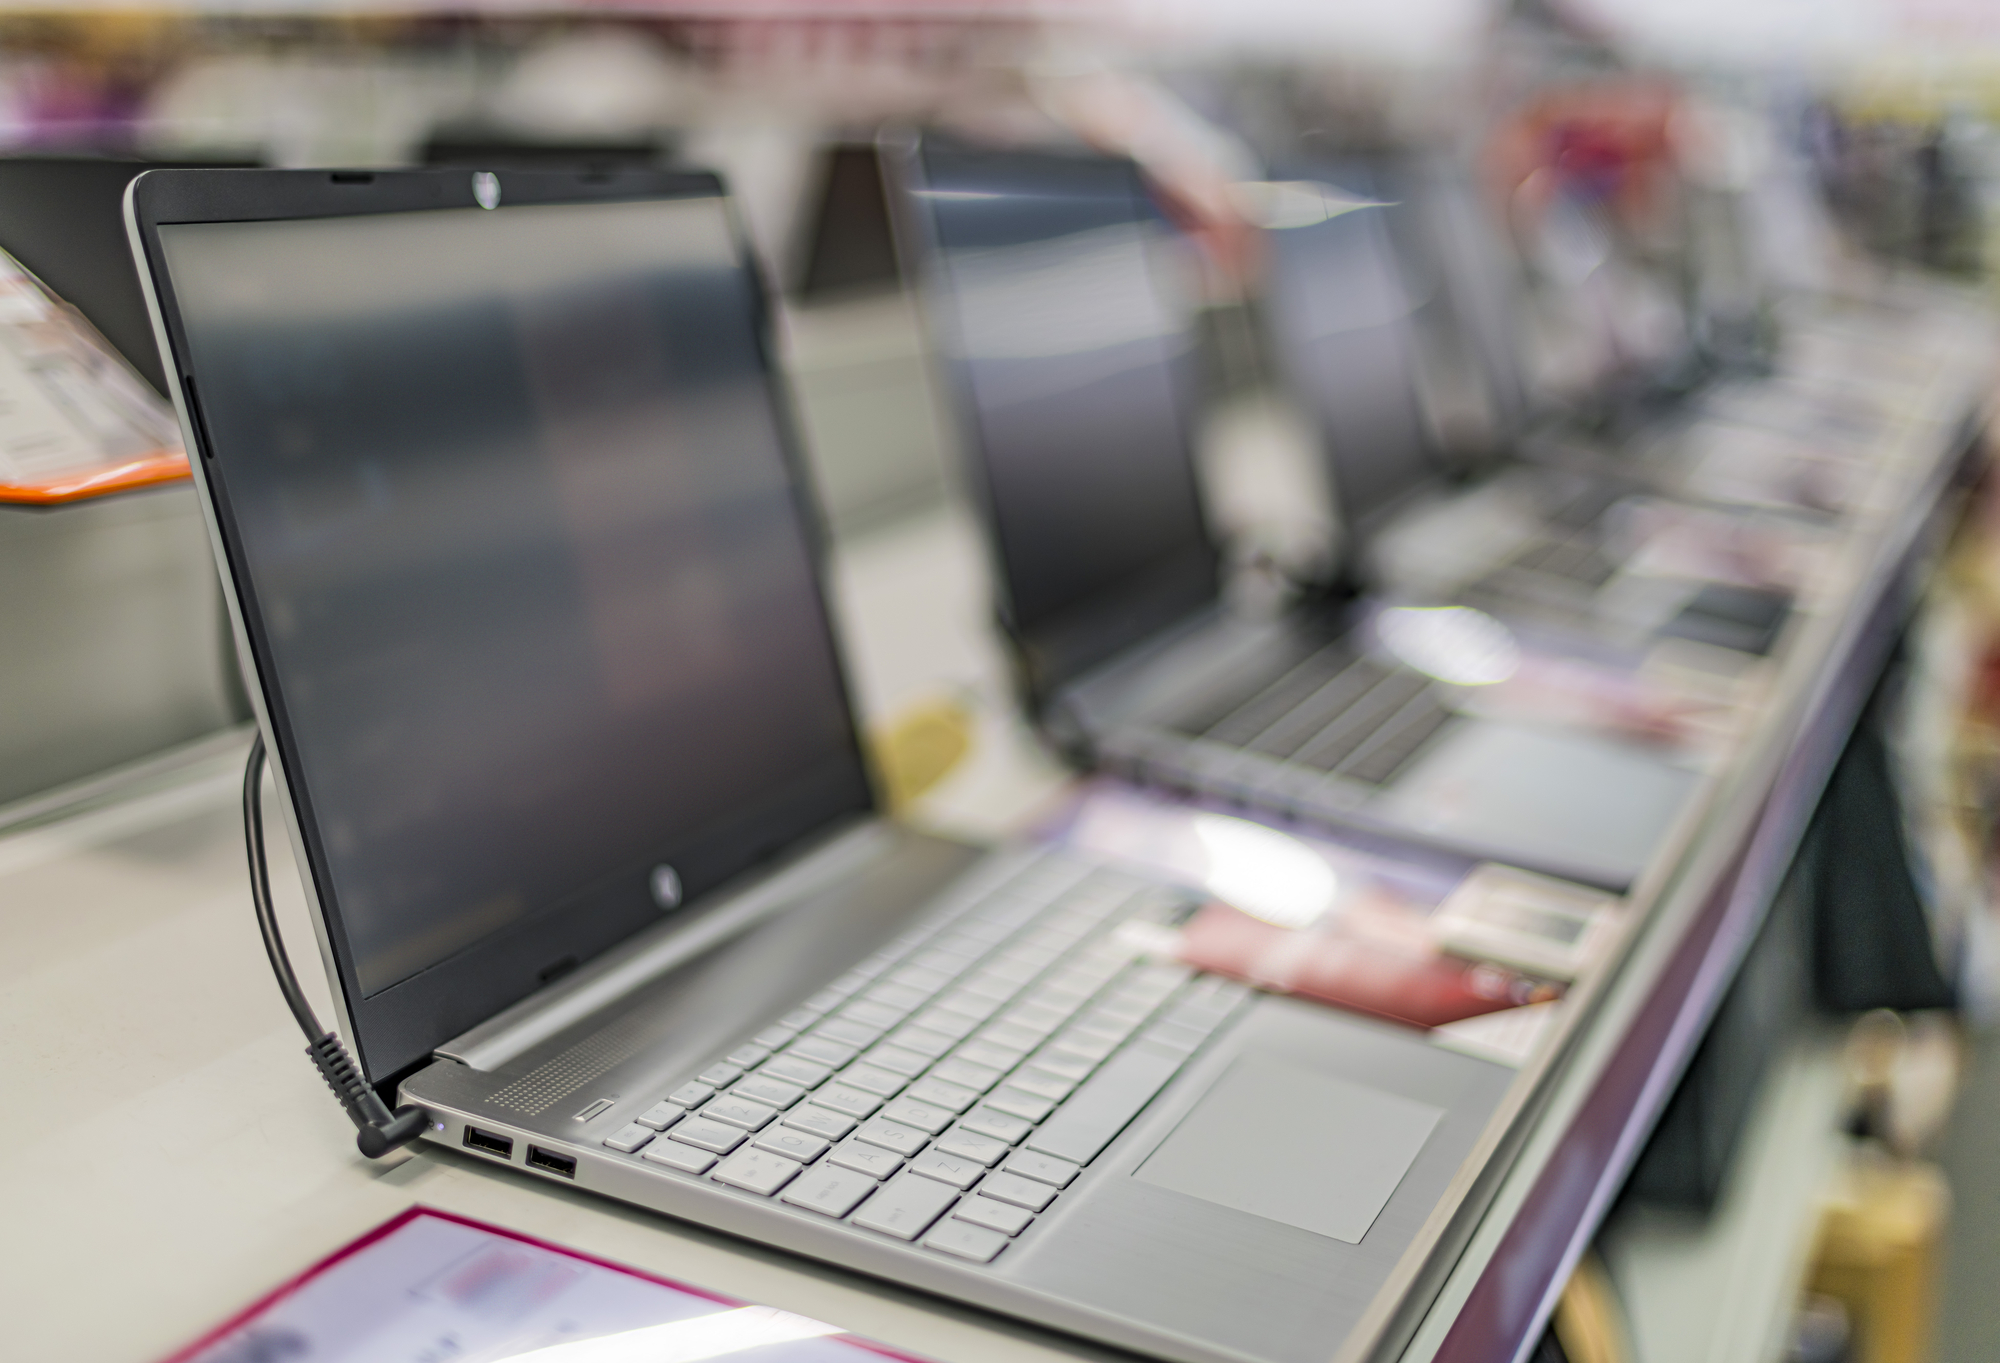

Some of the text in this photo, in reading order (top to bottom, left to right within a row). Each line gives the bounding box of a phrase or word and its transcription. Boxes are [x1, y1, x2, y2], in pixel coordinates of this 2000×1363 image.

[836, 1093, 858, 1103] E
[731, 1105, 750, 1116] 2
[907, 1108, 929, 1119] D
[806, 1112, 832, 1125] W
[987, 1117, 1008, 1128] C
[883, 1129, 905, 1140] S
[781, 1136, 805, 1146] Q
[961, 1138, 986, 1150] X
[857, 1152, 880, 1164] A
[936, 1161, 961, 1173] Z
